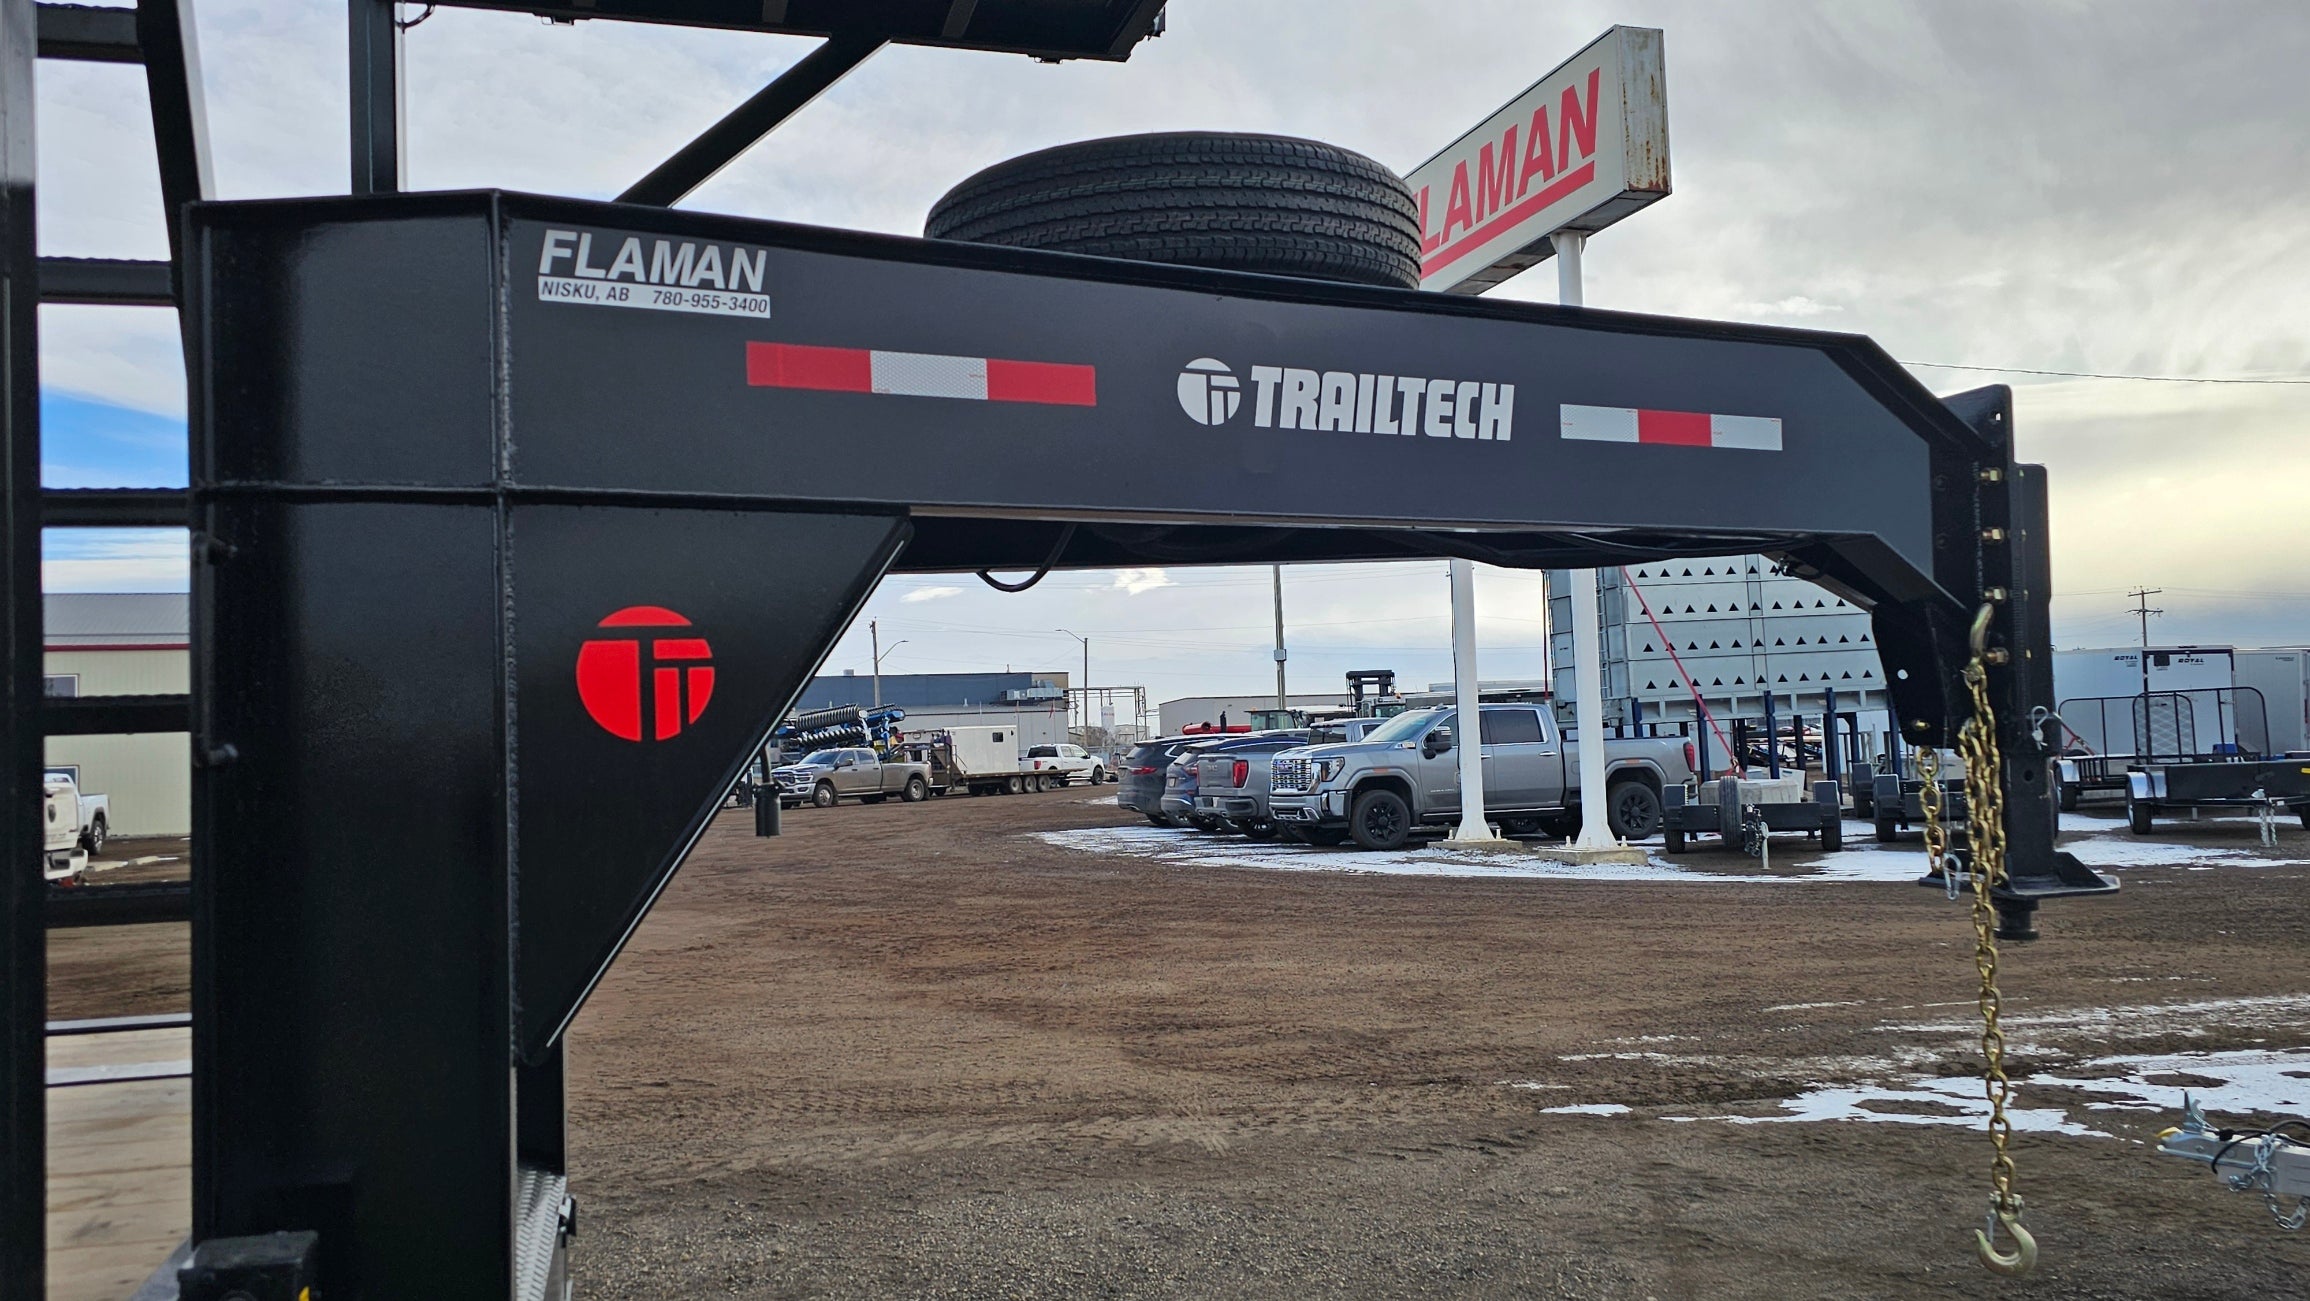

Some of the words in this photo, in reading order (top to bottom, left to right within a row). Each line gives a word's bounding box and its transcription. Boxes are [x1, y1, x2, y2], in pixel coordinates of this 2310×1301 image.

[1413, 66, 1600, 256] LAMAN
[538, 229, 767, 293] FLAMAN
[541, 280, 600, 303] NISKU,
[606, 286, 630, 302] AB
[652, 290, 768, 314] 780-955-3400
[1251, 365, 1515, 441] TRAILTECH
